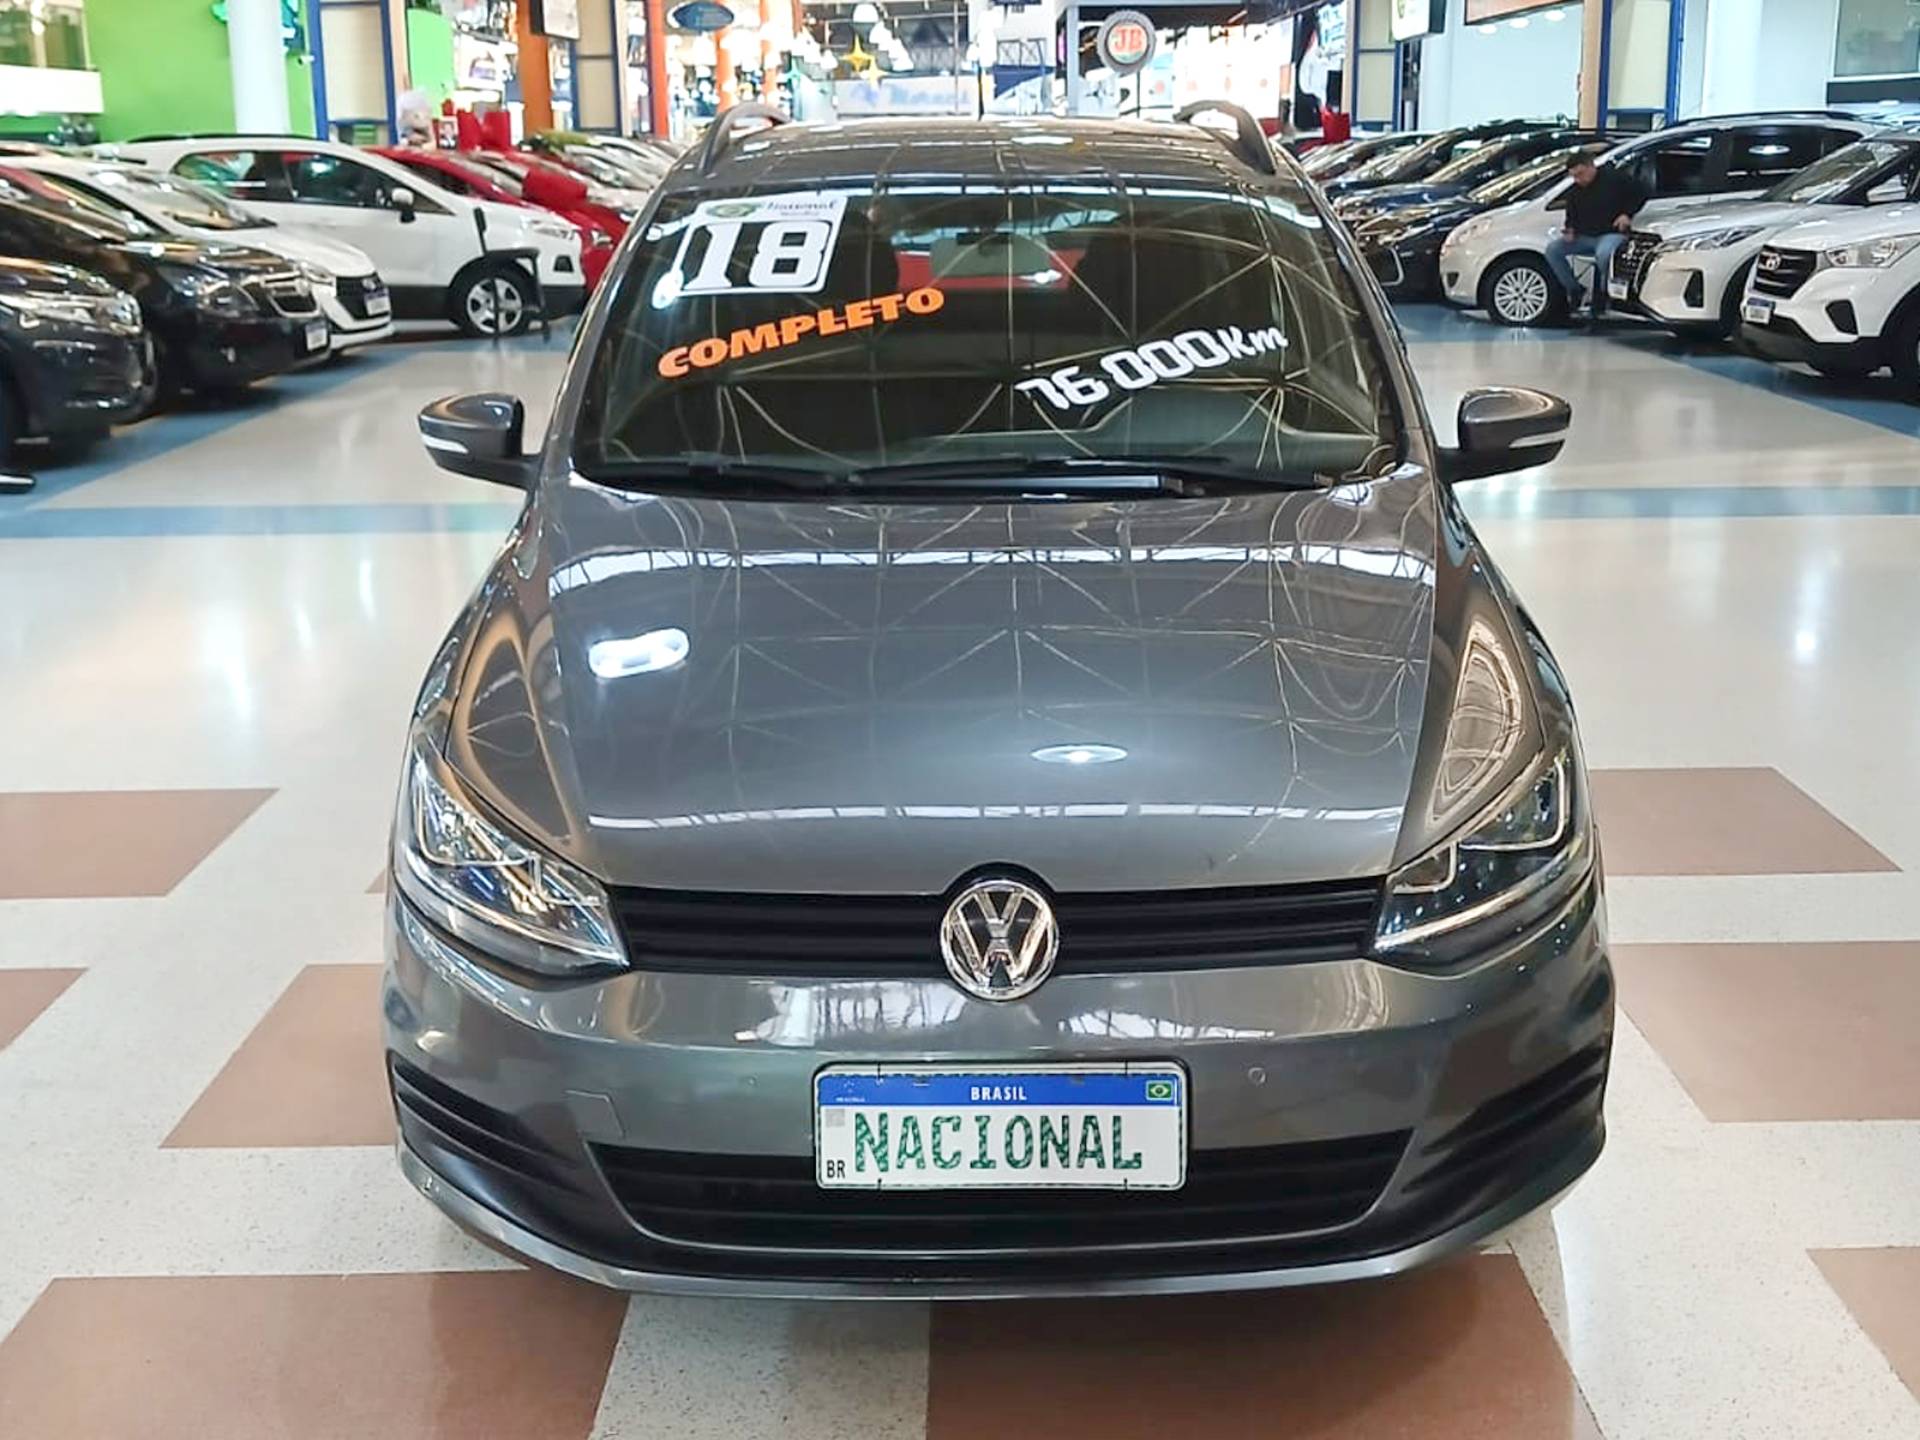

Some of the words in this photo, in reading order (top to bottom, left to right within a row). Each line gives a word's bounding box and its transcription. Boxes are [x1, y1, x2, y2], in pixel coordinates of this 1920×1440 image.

[684, 220, 831, 290] 18
[657, 287, 945, 378] COMPLETO
[970, 1086, 1027, 1101] BRASIL
[826, 1159, 847, 1180] BR
[854, 1112, 1143, 1172] NACIONAL
